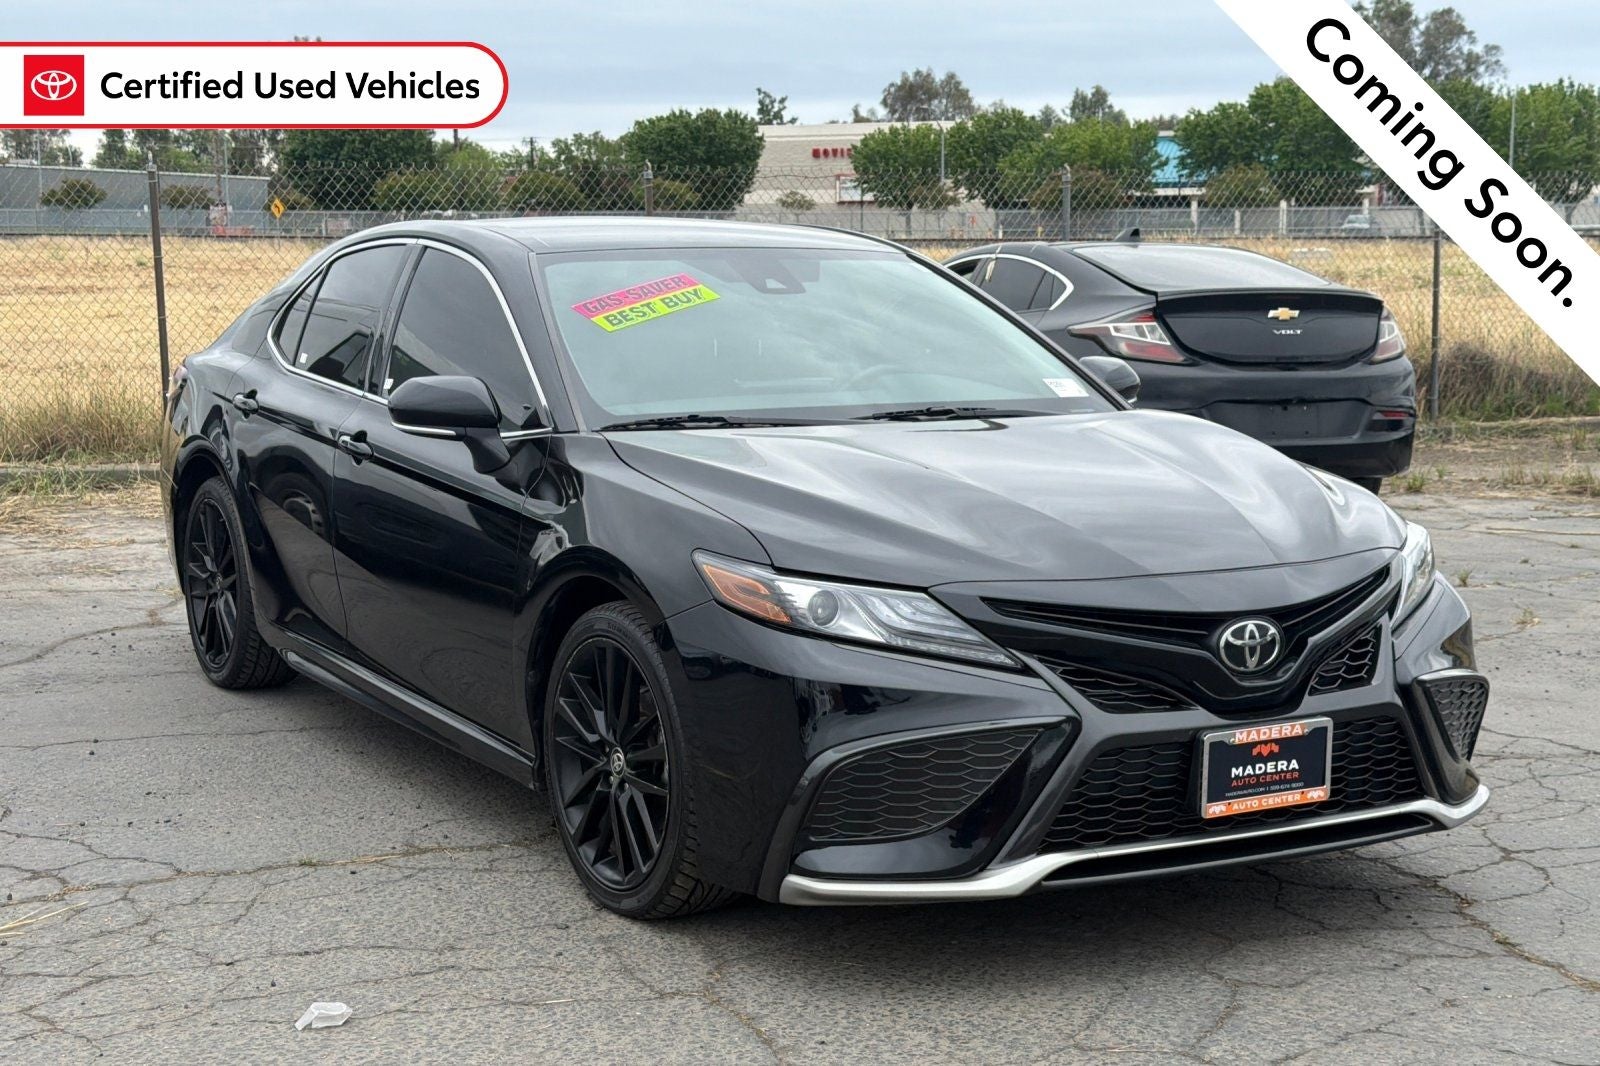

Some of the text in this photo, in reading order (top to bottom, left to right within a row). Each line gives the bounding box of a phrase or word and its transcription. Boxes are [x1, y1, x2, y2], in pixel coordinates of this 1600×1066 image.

[582, 276, 687, 314] GAS SAVER
[604, 288, 702, 327] BEST BUY
[1235, 724, 1303, 743] MADERA
[1231, 759, 1299, 778] MADERA
[1231, 772, 1299, 787] AUTO CENTER
[1232, 794, 1300, 810] AUTO CENTER
